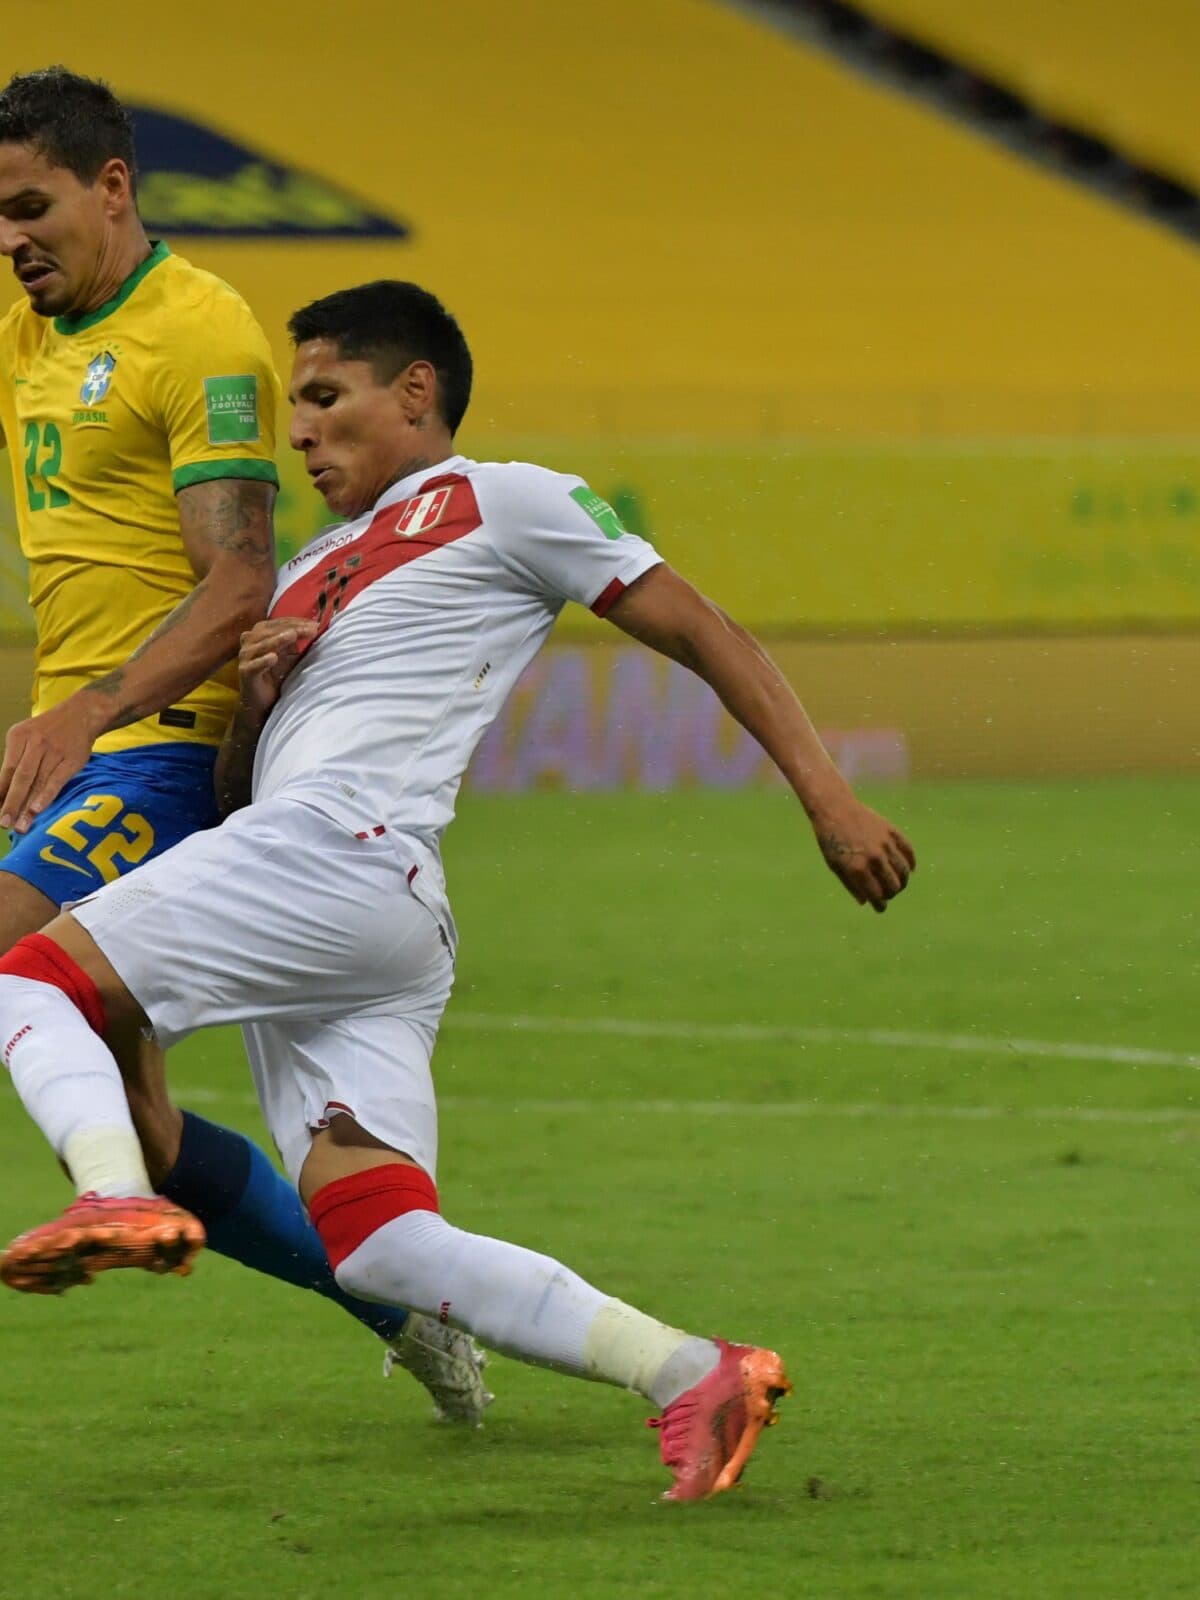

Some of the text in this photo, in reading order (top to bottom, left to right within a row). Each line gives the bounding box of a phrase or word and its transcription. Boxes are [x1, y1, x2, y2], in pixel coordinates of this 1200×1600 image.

[73, 411, 109, 424] BRASIL
[24, 422, 71, 512] 22
[405, 502, 441, 521] FPF
[288, 532, 354, 571] marathon
[46, 794, 155, 884] 22
